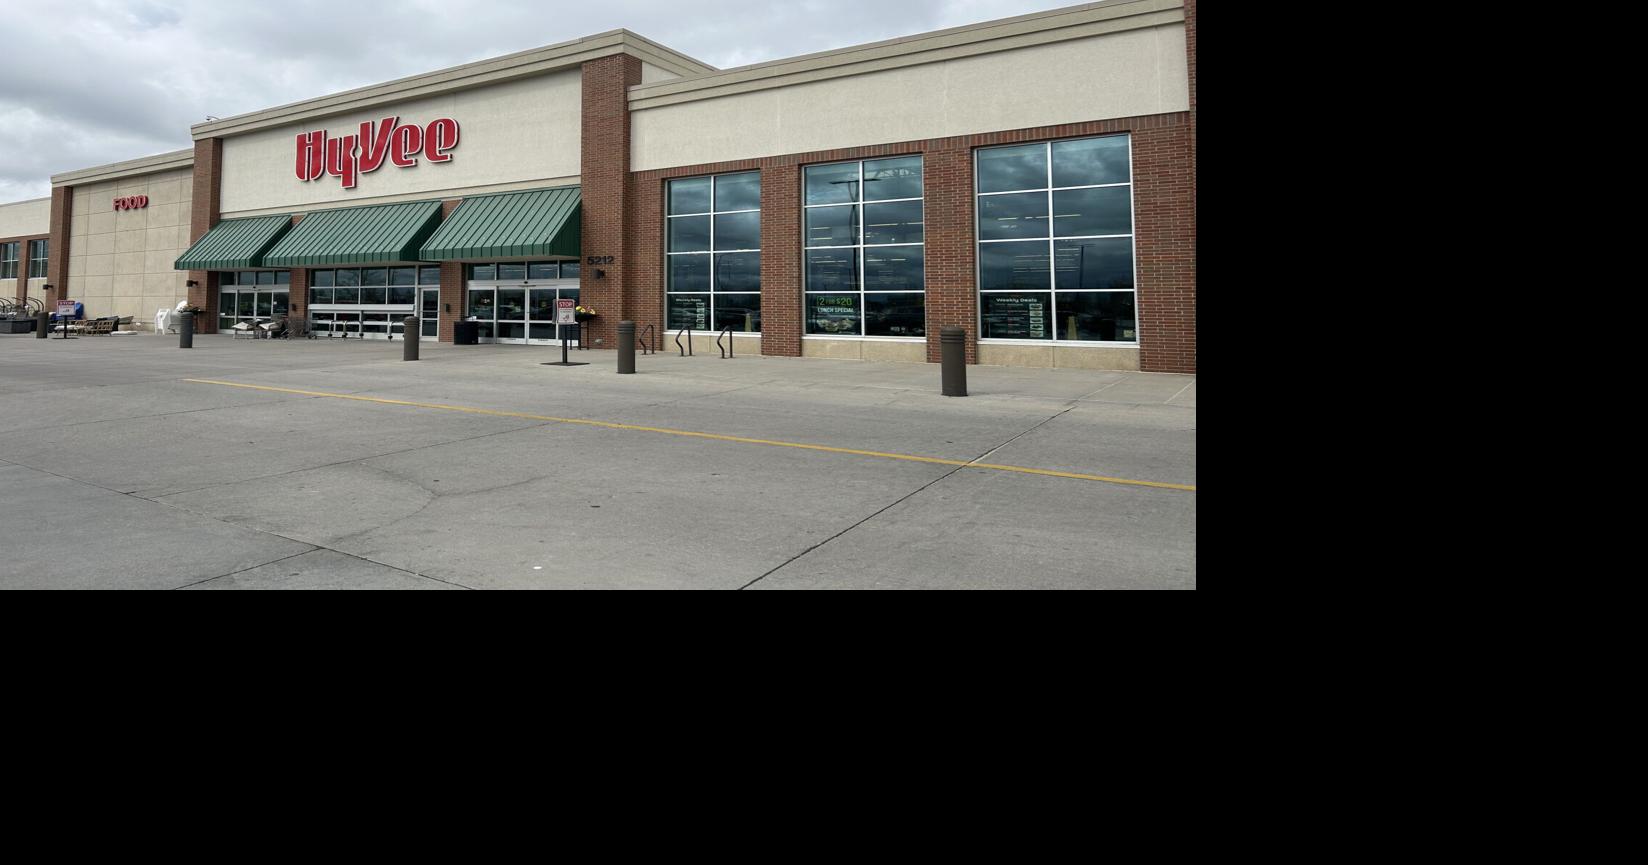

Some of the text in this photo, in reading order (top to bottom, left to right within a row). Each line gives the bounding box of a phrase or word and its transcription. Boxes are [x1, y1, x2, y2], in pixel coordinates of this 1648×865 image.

[112, 195, 149, 211] FOOD
[587, 255, 615, 265] 5212
[819, 297, 825, 305] 2
[836, 297, 853, 305] $20
